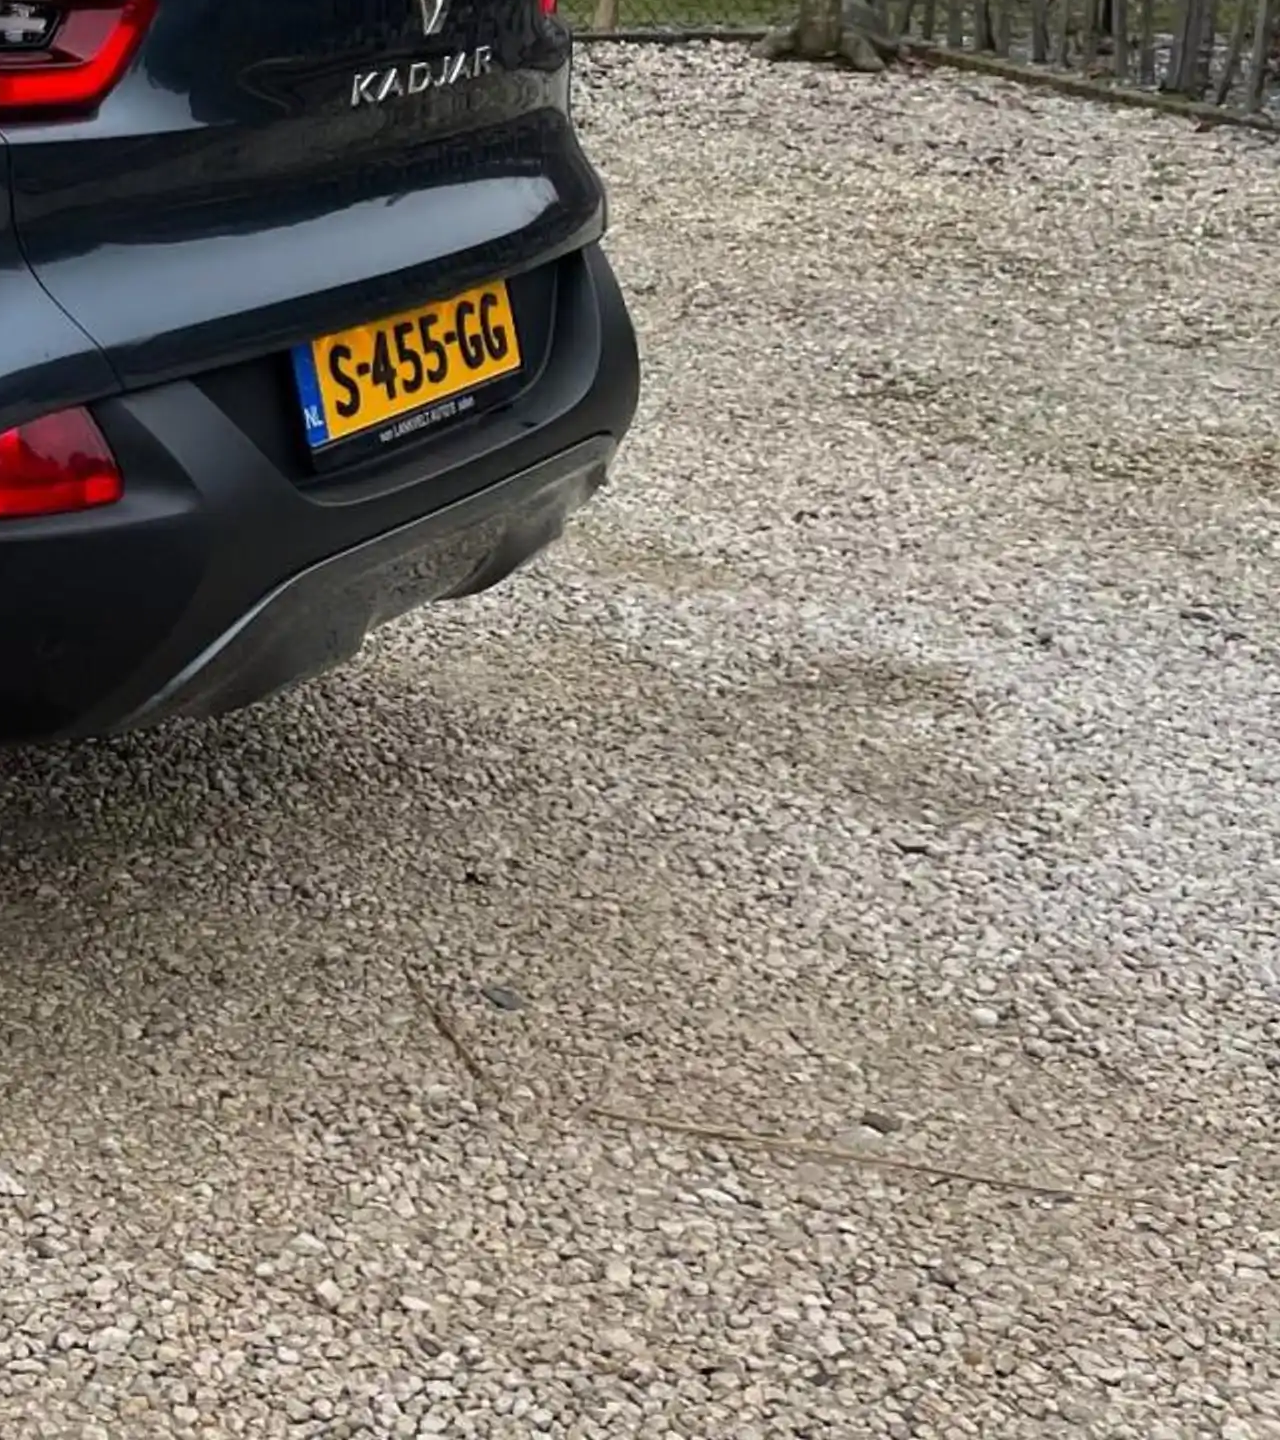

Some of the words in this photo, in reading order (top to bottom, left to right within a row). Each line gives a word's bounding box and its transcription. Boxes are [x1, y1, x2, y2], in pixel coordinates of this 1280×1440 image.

[351, 45, 492, 107] KADJAR
[329, 292, 508, 418] S-455-GG
[303, 405, 324, 430] NL
